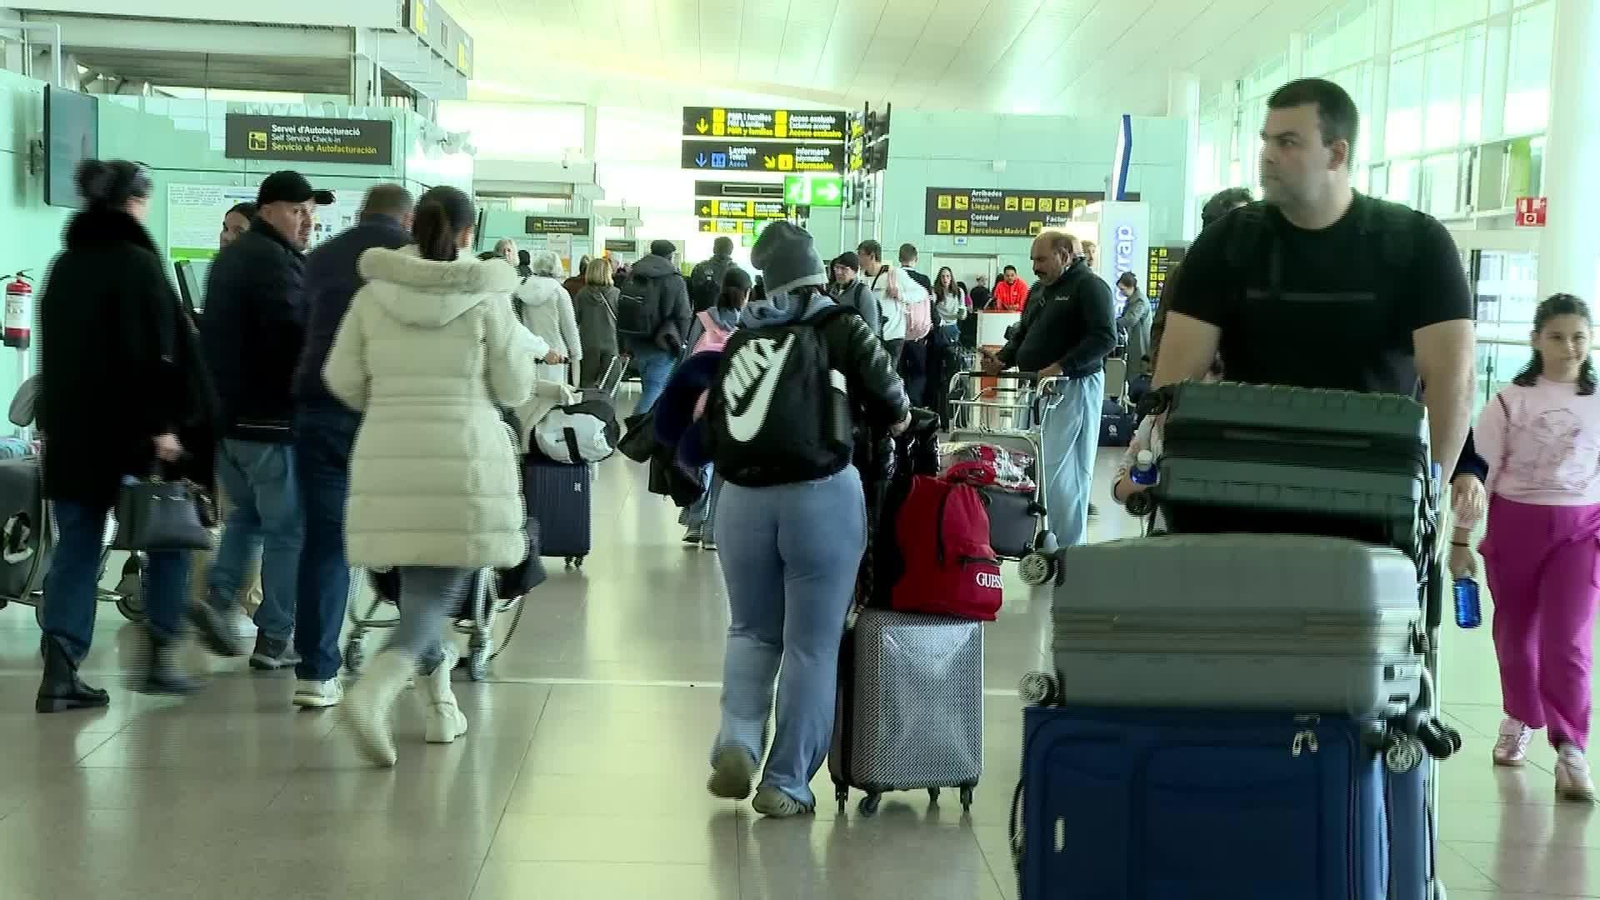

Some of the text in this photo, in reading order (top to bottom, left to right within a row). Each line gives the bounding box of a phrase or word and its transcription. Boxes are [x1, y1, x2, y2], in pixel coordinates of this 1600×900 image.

[271, 124, 361, 136] Servei d'Autofacturació
[271, 134, 341, 143] Self Service Check-in
[271, 142, 377, 154] Servicio de Autofacturación
[728, 146, 757, 155] Lavabos
[971, 190, 1003, 198] Arribades
[970, 213, 1000, 221] Corredor
[722, 338, 779, 411] NIKE
[976, 571, 1003, 589] GUES
